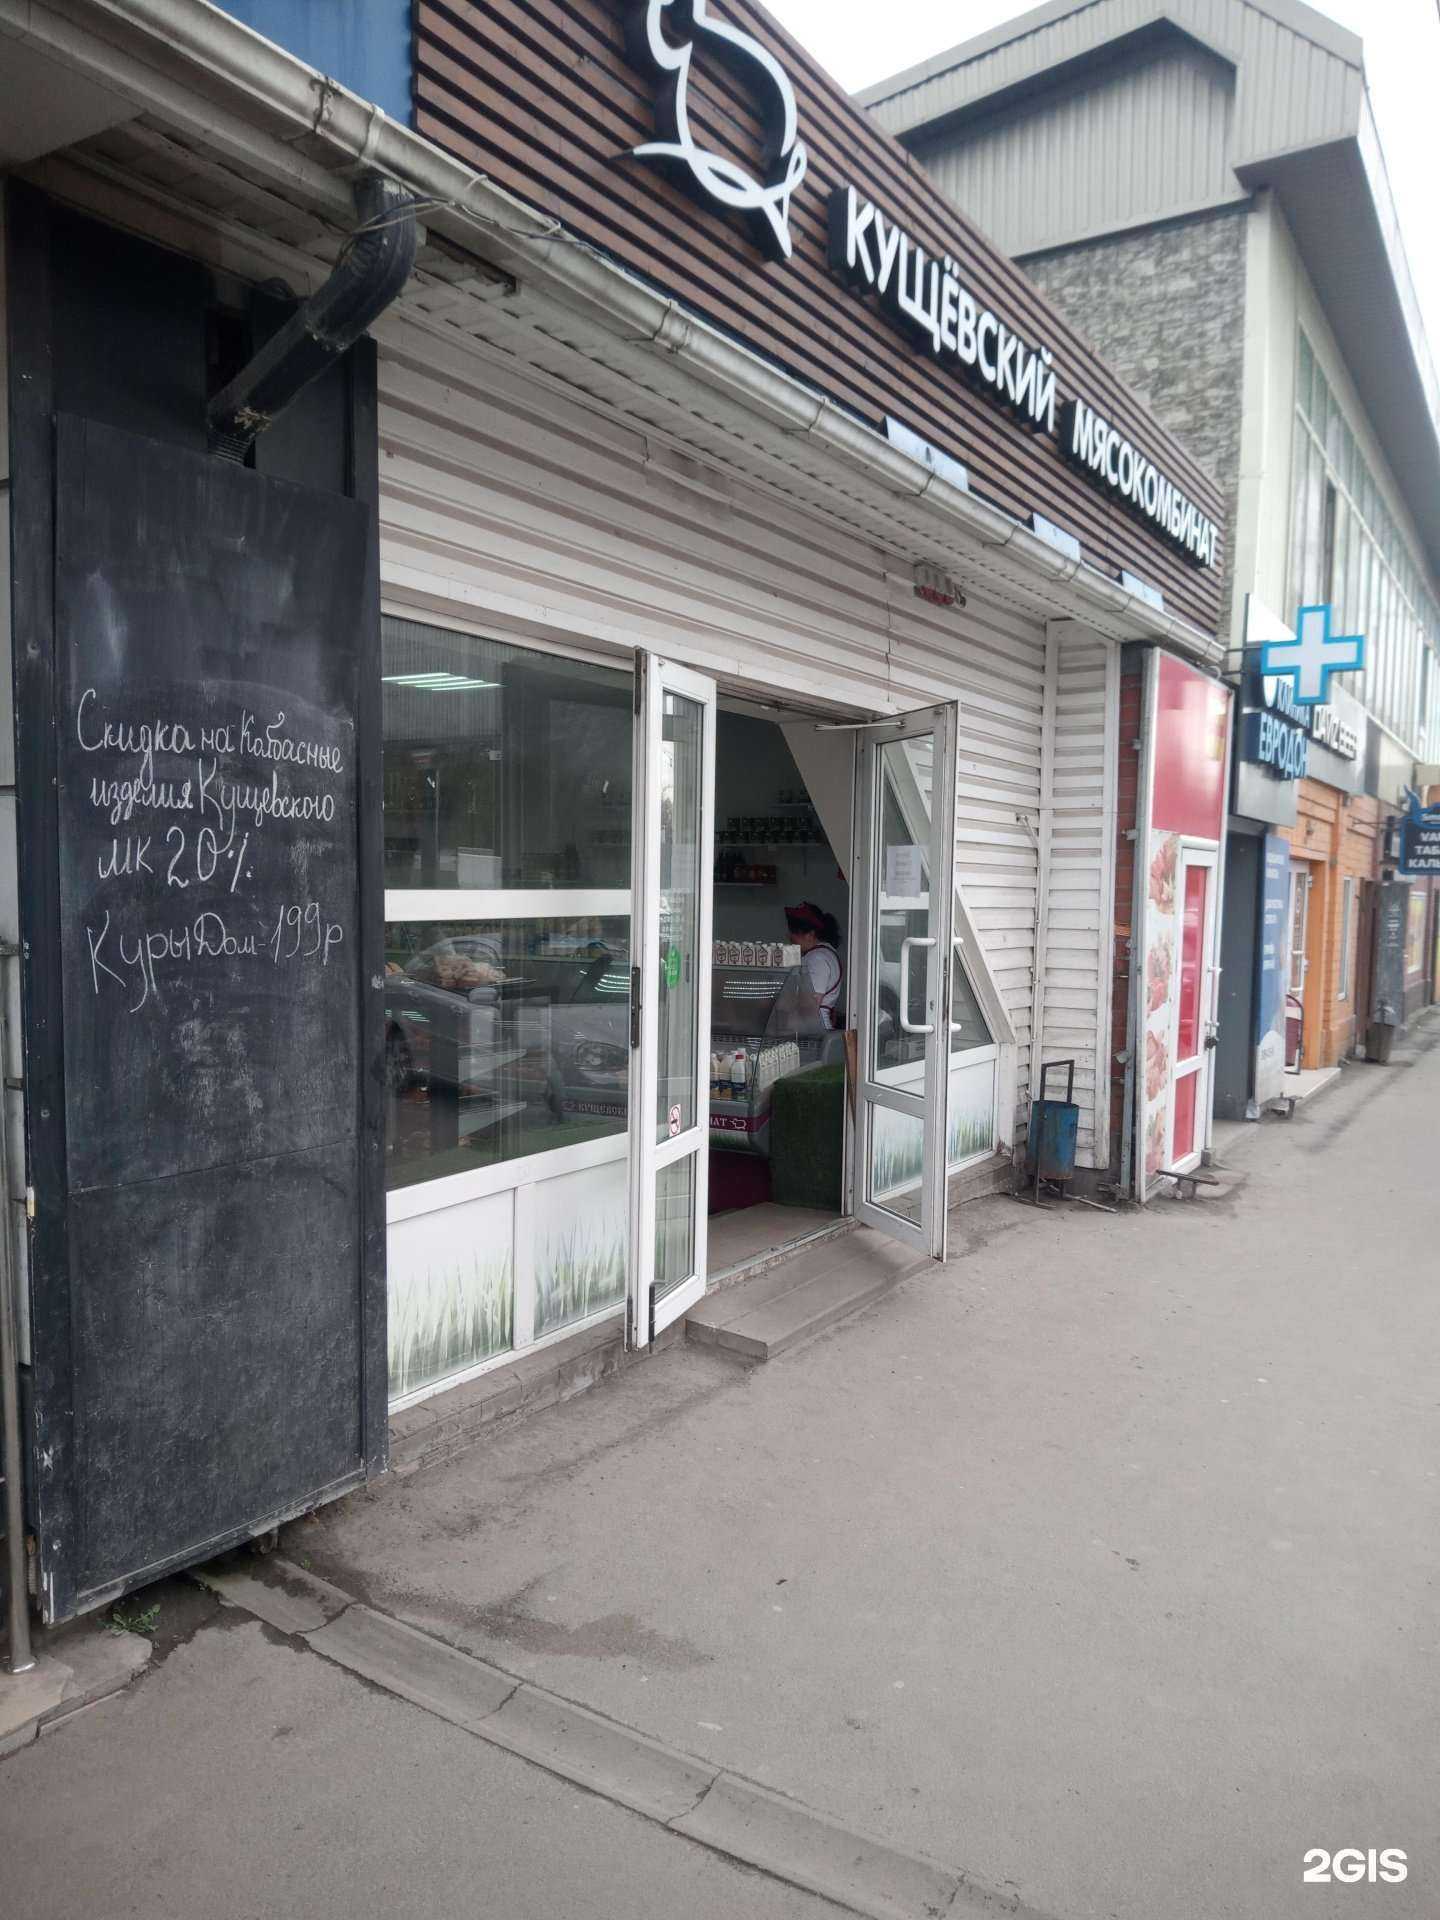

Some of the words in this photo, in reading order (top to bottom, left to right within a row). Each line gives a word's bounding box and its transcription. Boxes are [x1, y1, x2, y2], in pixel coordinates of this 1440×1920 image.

[847, 185, 1057, 432] КУЩЁВСКИЙ
[1072, 399, 1219, 568] МЯСОКОМБИНАТ
[77, 688, 196, 791] Скидка
[201, 725, 236, 753] на
[1258, 712, 1308, 780] ЕВРОДОН
[90, 778, 194, 825] изделия
[198, 757, 335, 851] Кущевского
[87, 910, 190, 1013] Куры
